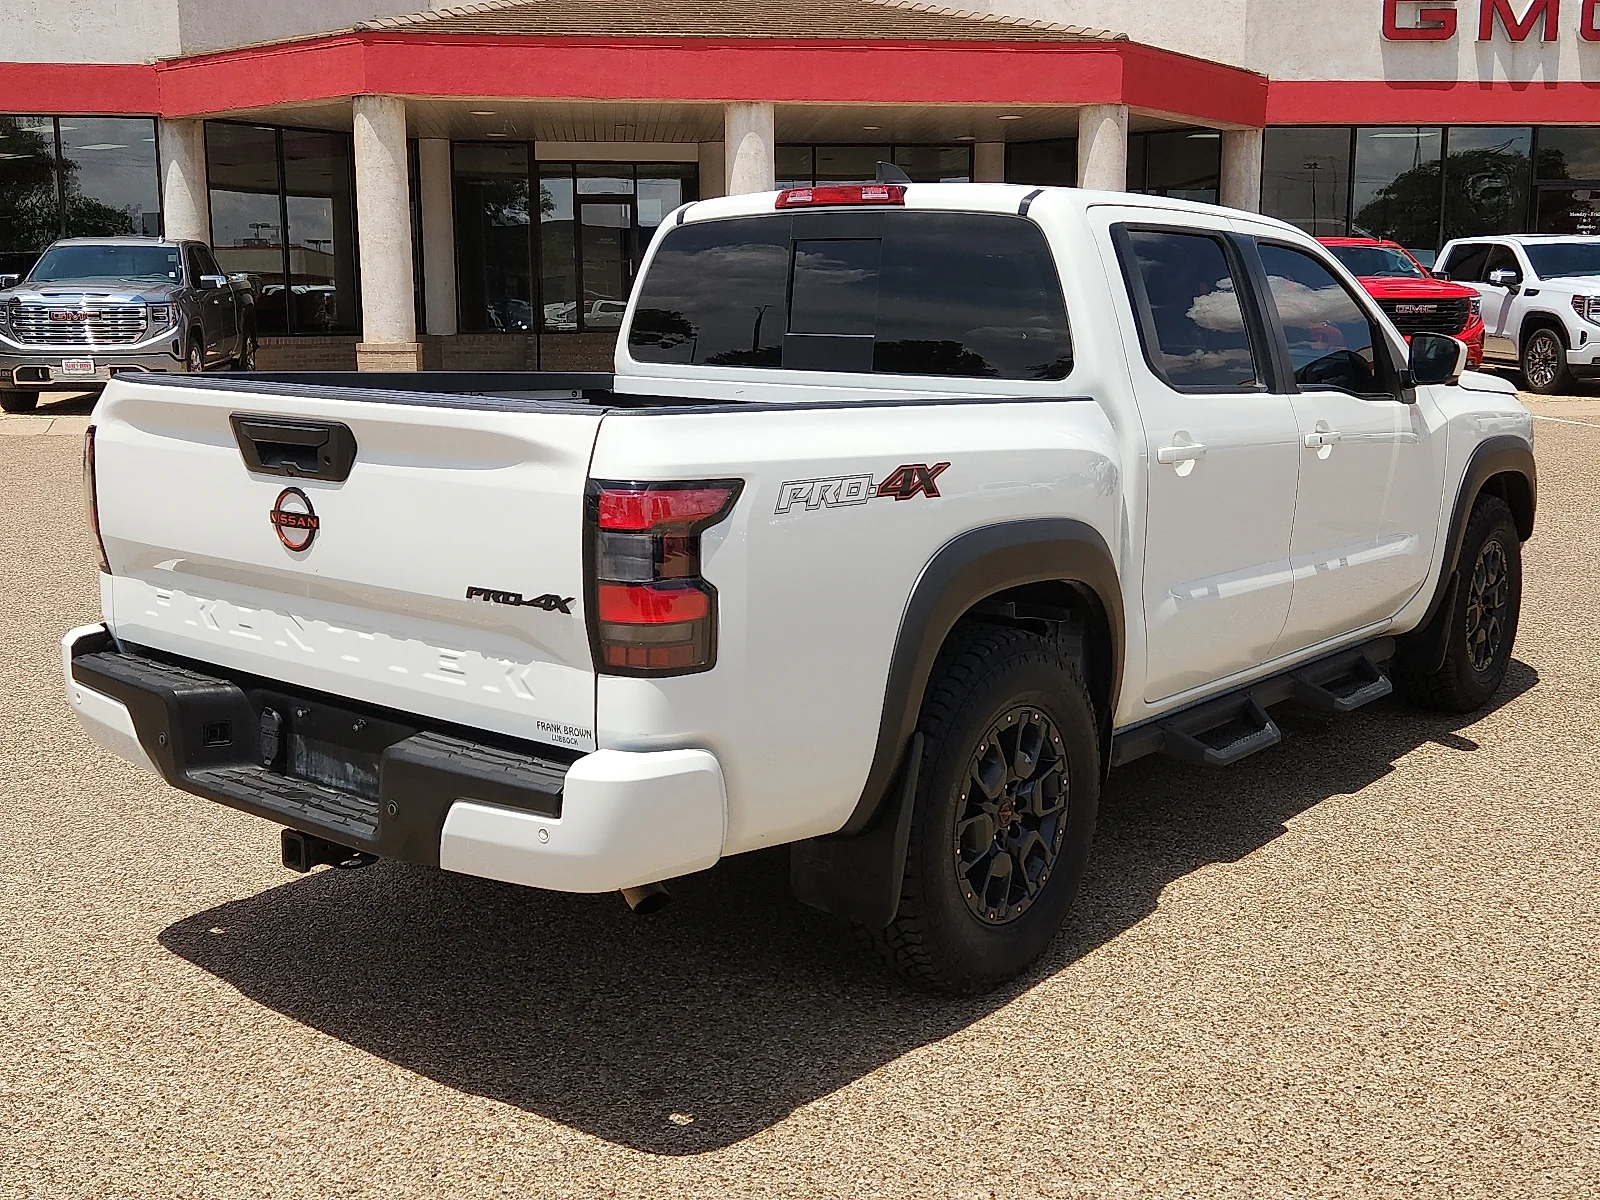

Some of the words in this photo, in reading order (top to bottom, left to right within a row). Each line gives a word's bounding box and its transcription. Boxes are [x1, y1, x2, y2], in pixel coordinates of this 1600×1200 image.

[1382, 0, 1600, 41] GM
[51, 311, 100, 320] GMC
[1395, 304, 1438, 314] GMC
[773, 461, 952, 515] PRO-4X
[271, 512, 318, 528] NISSAN
[465, 586, 577, 615] PRO-4X
[536, 720, 562, 734] FRANK
[563, 725, 592, 739] BROWN
[551, 734, 579, 745] LUBBOCK
